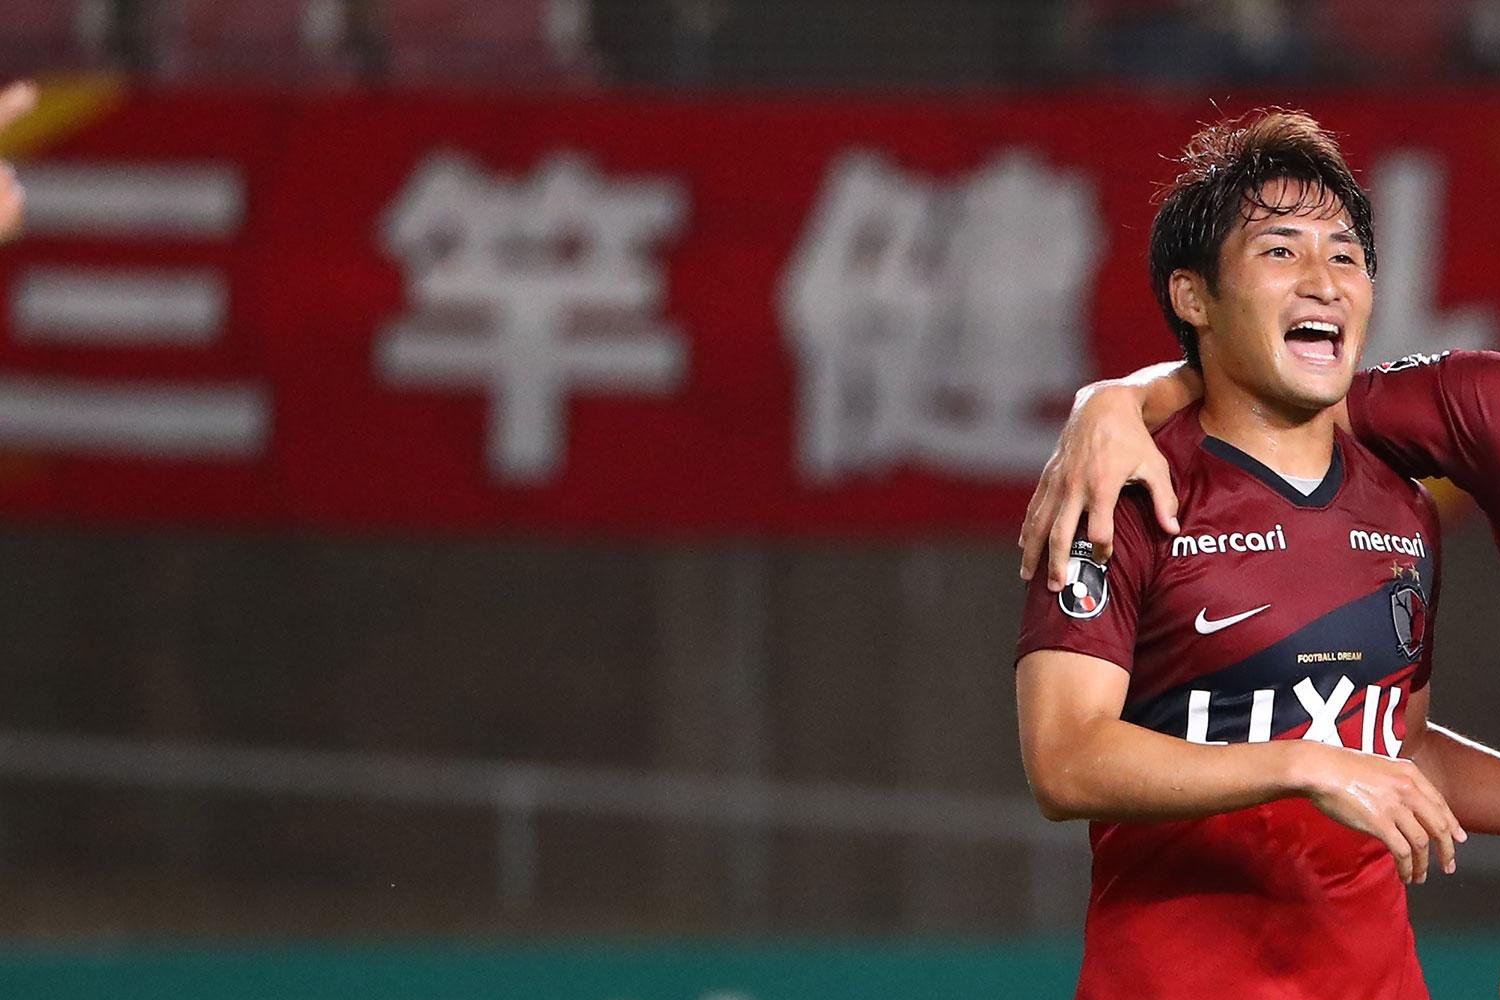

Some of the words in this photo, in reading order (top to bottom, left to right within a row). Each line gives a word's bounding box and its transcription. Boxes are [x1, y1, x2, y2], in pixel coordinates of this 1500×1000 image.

[1171, 524, 1287, 557] mercari
[1350, 529, 1425, 558] mercari
[1297, 652, 1336, 664] FOOTBALL
[1337, 651, 1362, 662] DREAM
